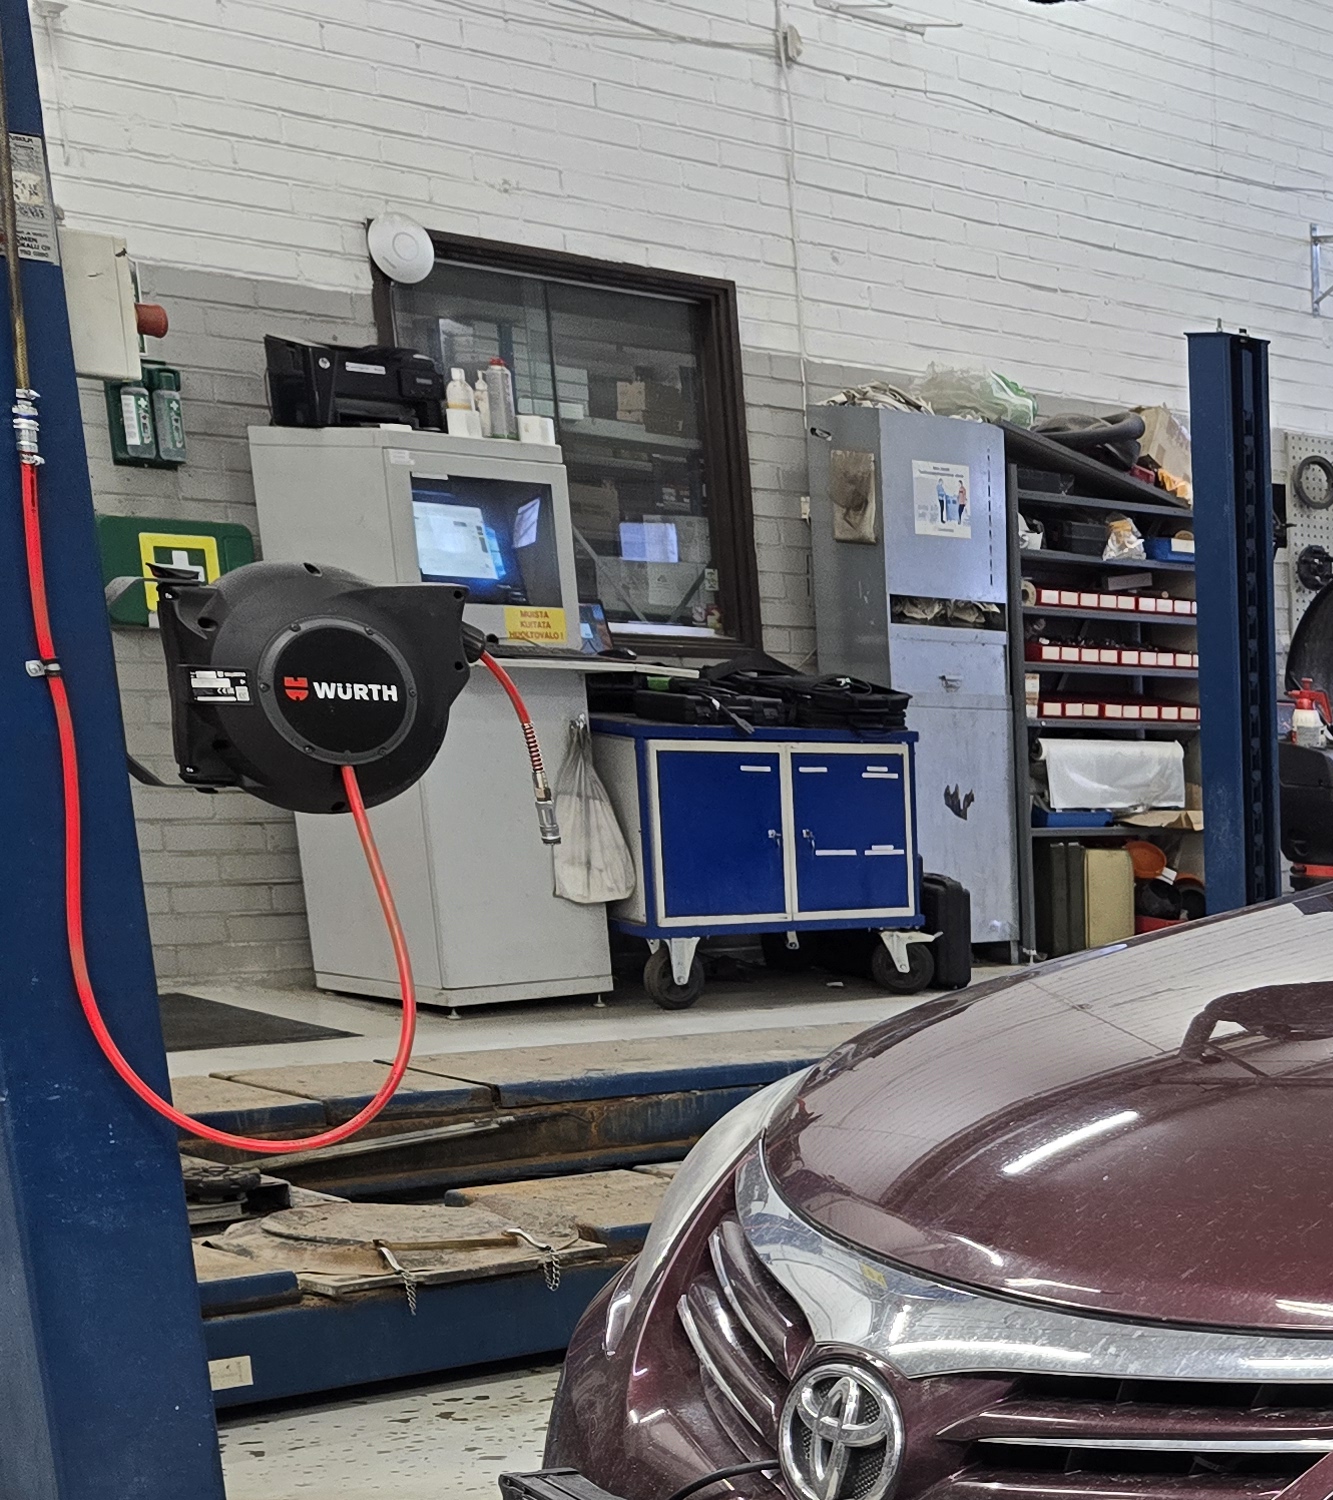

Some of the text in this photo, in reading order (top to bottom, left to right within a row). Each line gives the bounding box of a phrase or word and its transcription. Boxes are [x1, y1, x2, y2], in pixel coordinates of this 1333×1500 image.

[520, 610, 549, 618] MUISTA
[520, 621, 551, 629] KUITATA
[313, 682, 398, 701] WÜRTH
